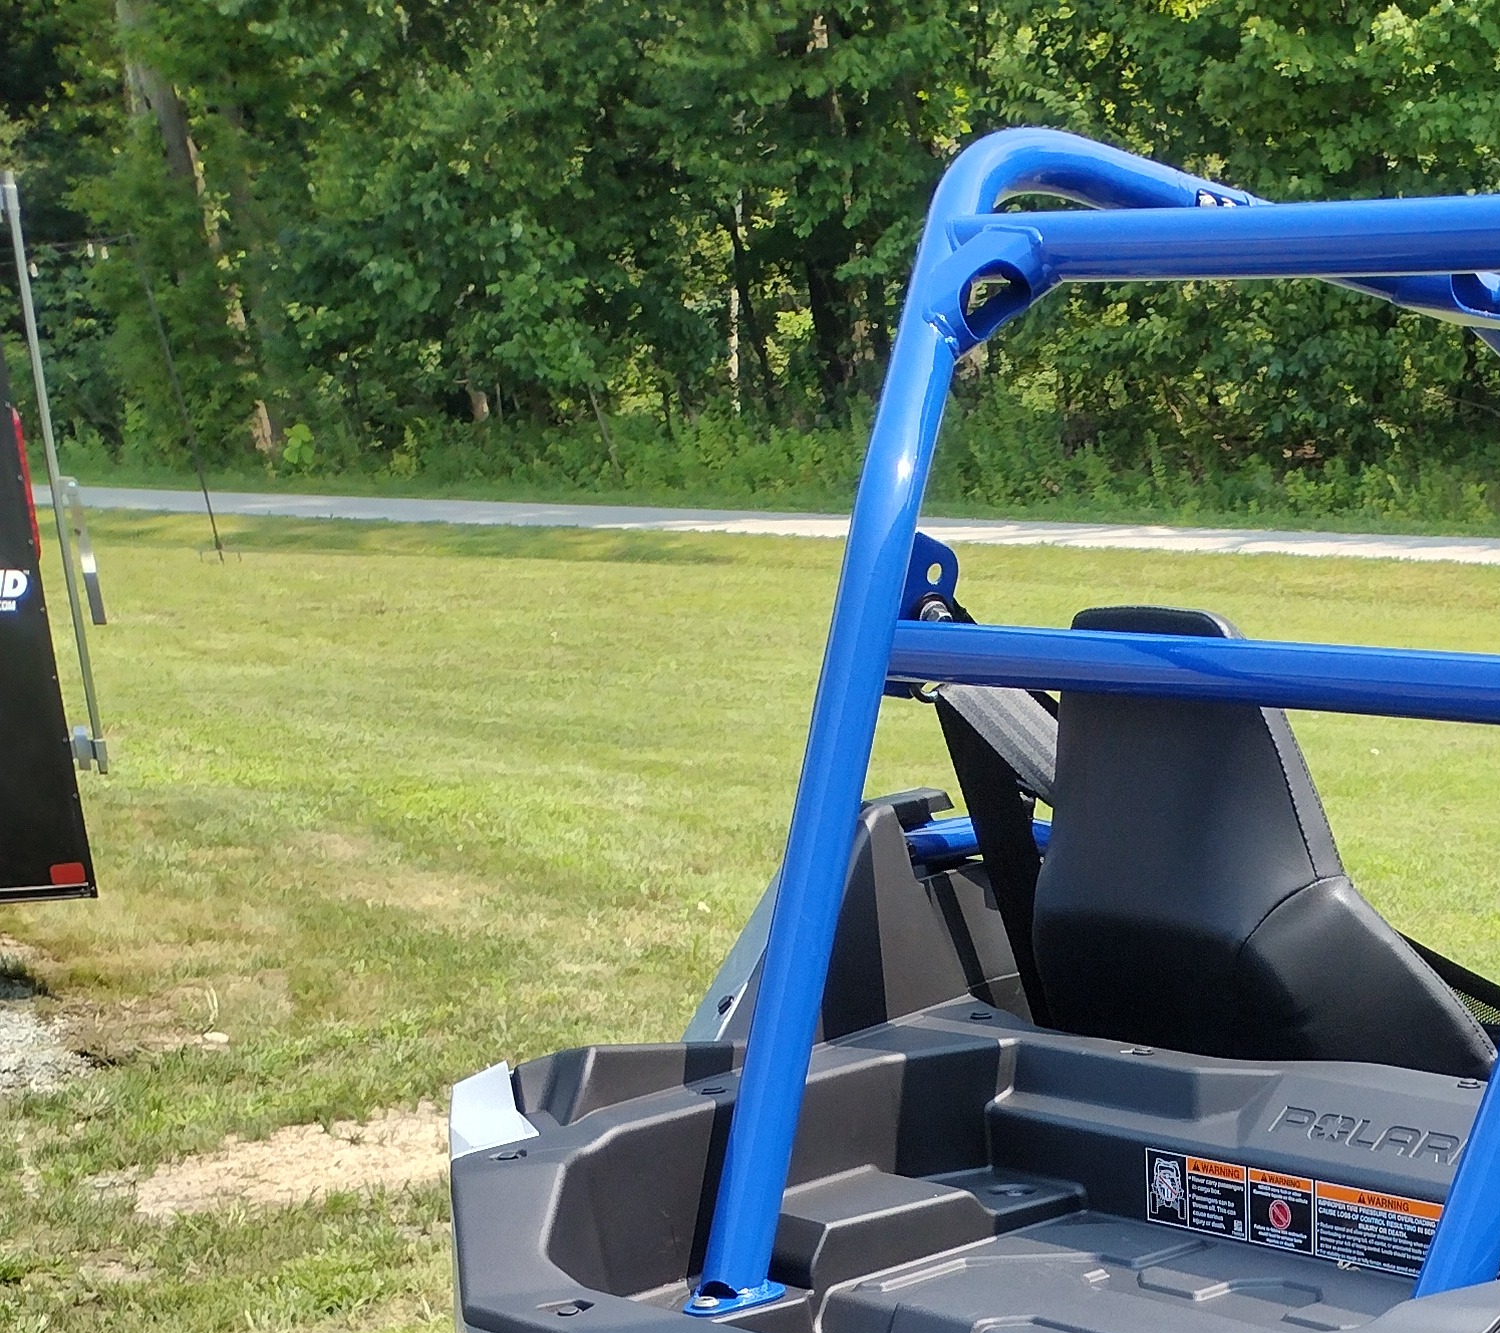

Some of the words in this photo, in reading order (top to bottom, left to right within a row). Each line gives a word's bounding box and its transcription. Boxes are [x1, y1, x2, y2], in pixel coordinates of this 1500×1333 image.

[0, 569, 28, 598] D
[1268, 1105, 1469, 1166] POLARI
[1201, 1162, 1240, 1179] WARNING
[1268, 1173, 1301, 1189] WARNING
[1367, 1194, 1410, 1212] WARNING
